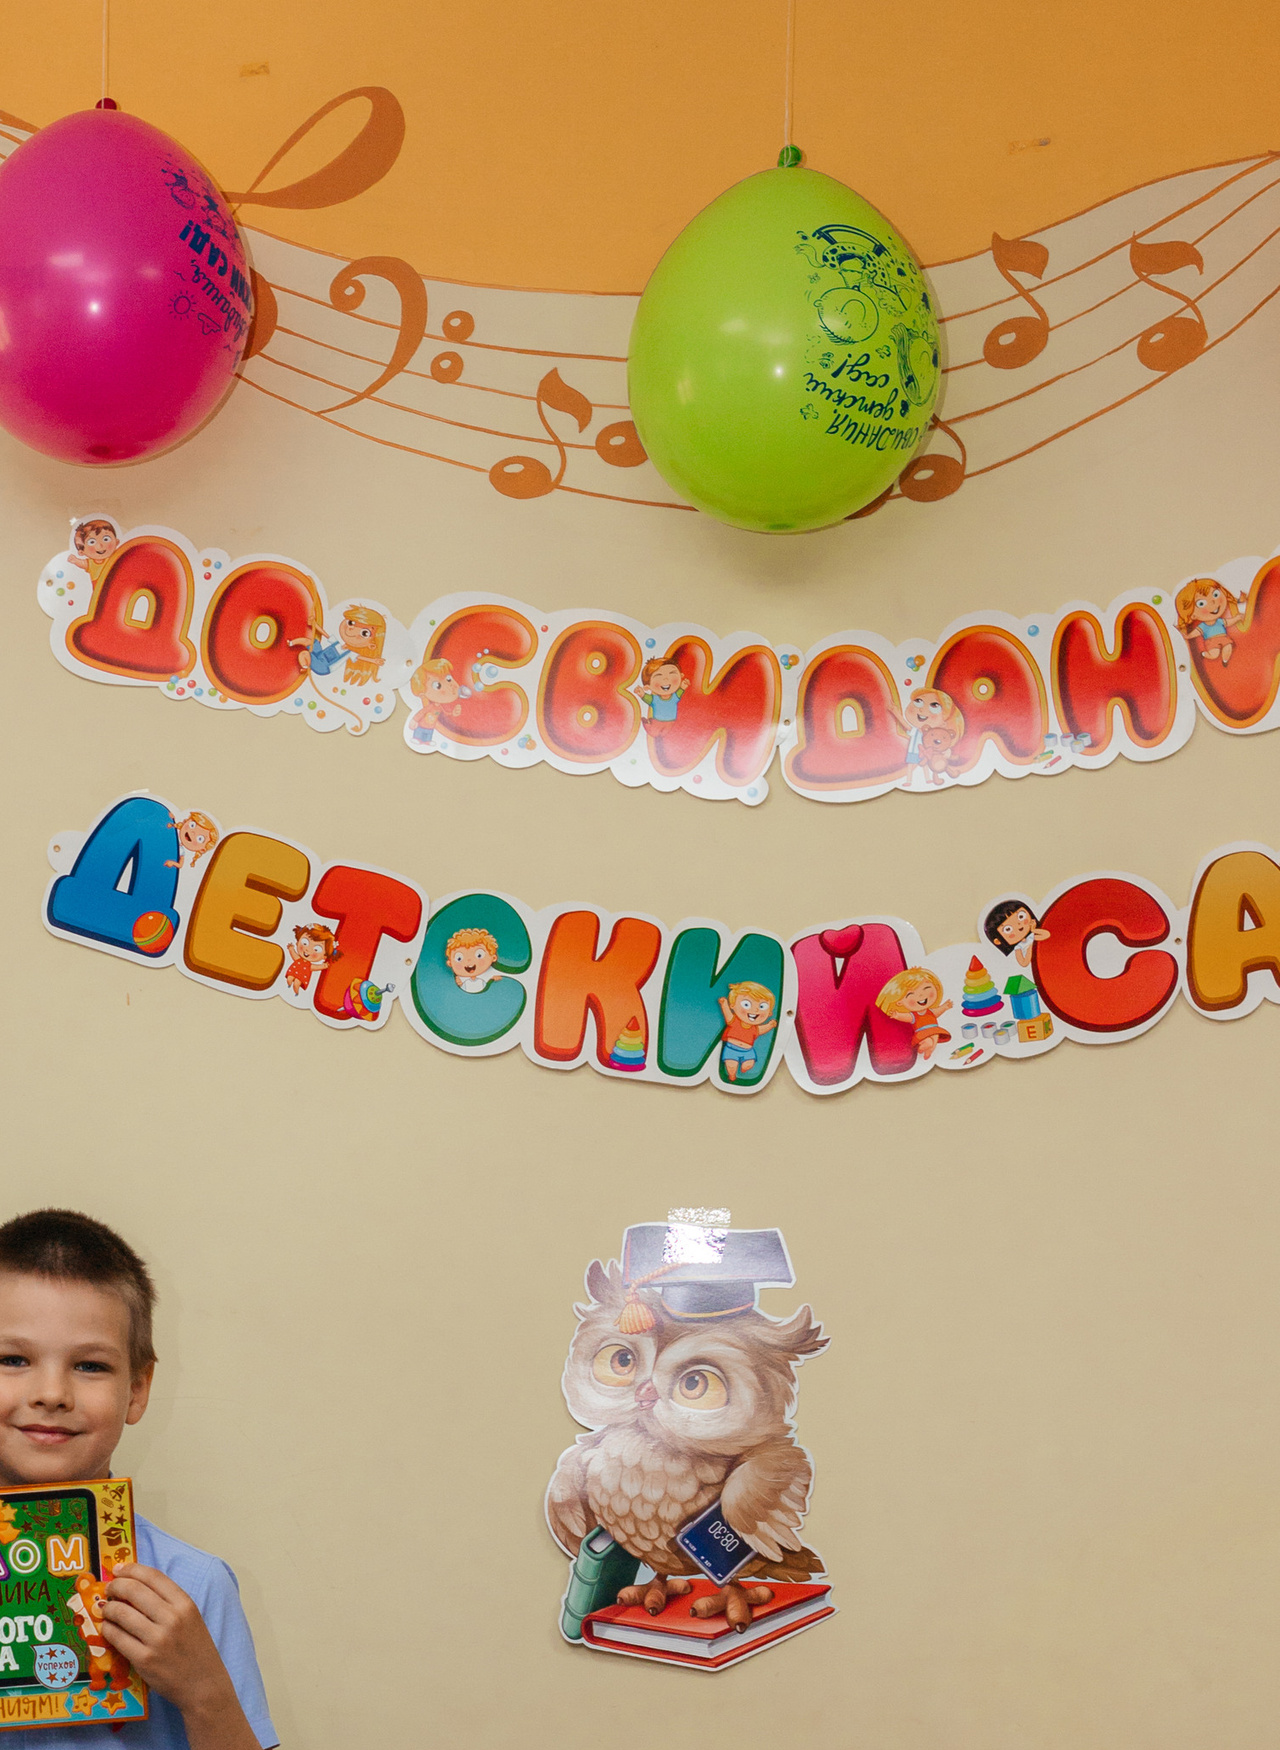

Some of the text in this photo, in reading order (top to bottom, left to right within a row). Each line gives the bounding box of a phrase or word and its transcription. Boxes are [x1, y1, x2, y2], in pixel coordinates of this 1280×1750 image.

[178, 219, 229, 277] САД!
[803, 372, 899, 421] детский
[830, 352, 890, 389] сад!
[64, 534, 324, 700] ДО
[43, 797, 924, 1087] ДЕТСКИЙ
[708, 1520, 740, 1553] 08:30
